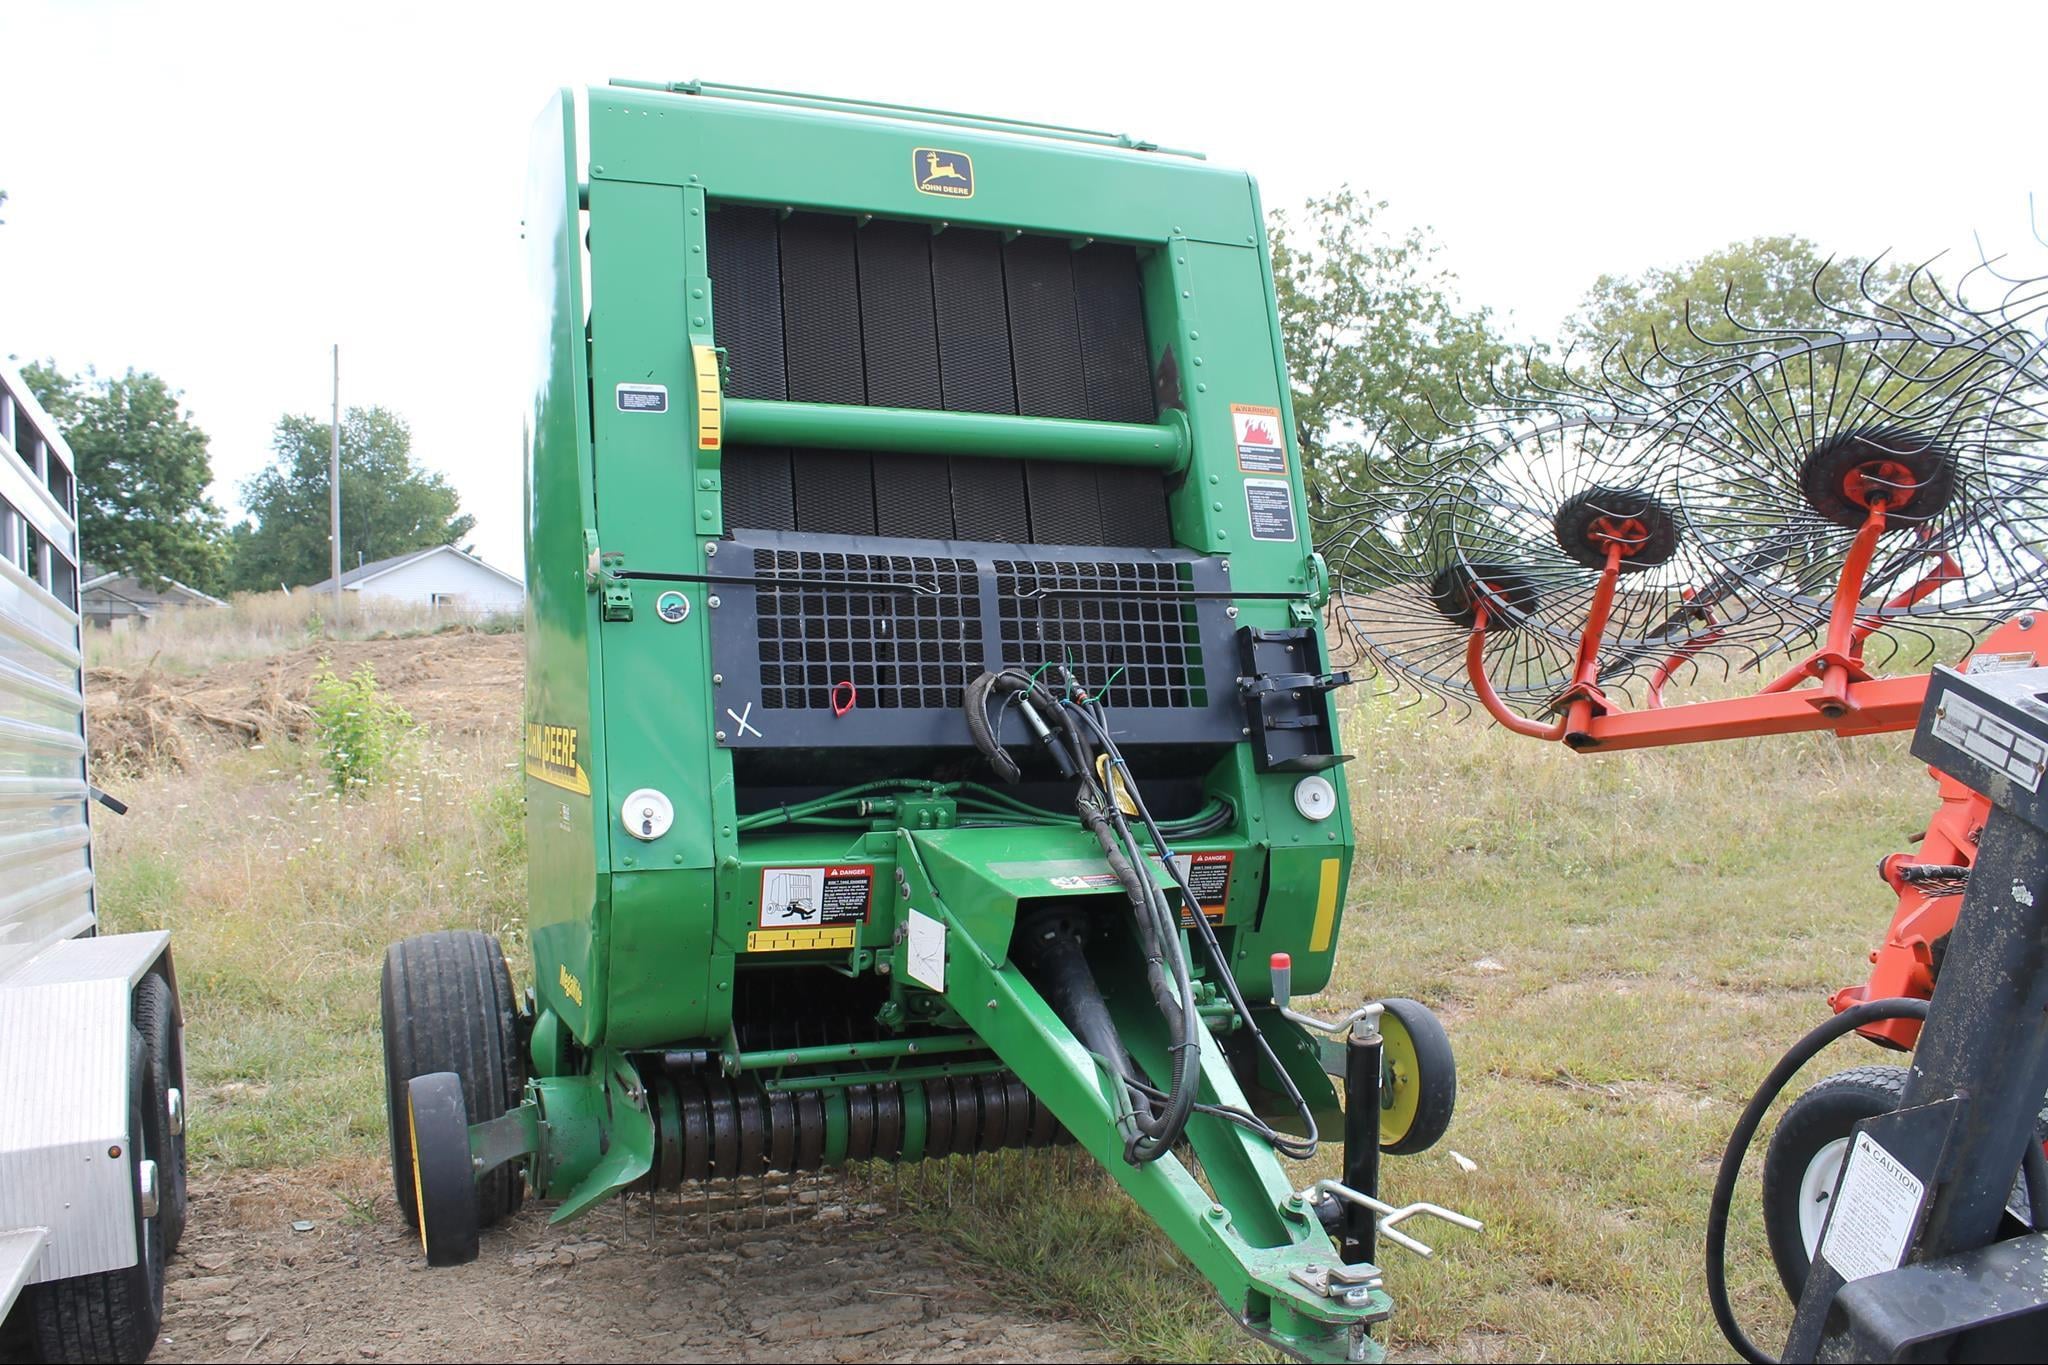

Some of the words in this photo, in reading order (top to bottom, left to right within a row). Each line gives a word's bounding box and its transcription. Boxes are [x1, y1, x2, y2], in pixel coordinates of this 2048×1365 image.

[920, 183, 942, 192] JOHN
[943, 186, 969, 195] DEERE
[1241, 405, 1275, 415] WARNING
[528, 723, 542, 759] OHN
[544, 725, 577, 769] DEERE
[1873, 1150, 1918, 1194] CAUTION
